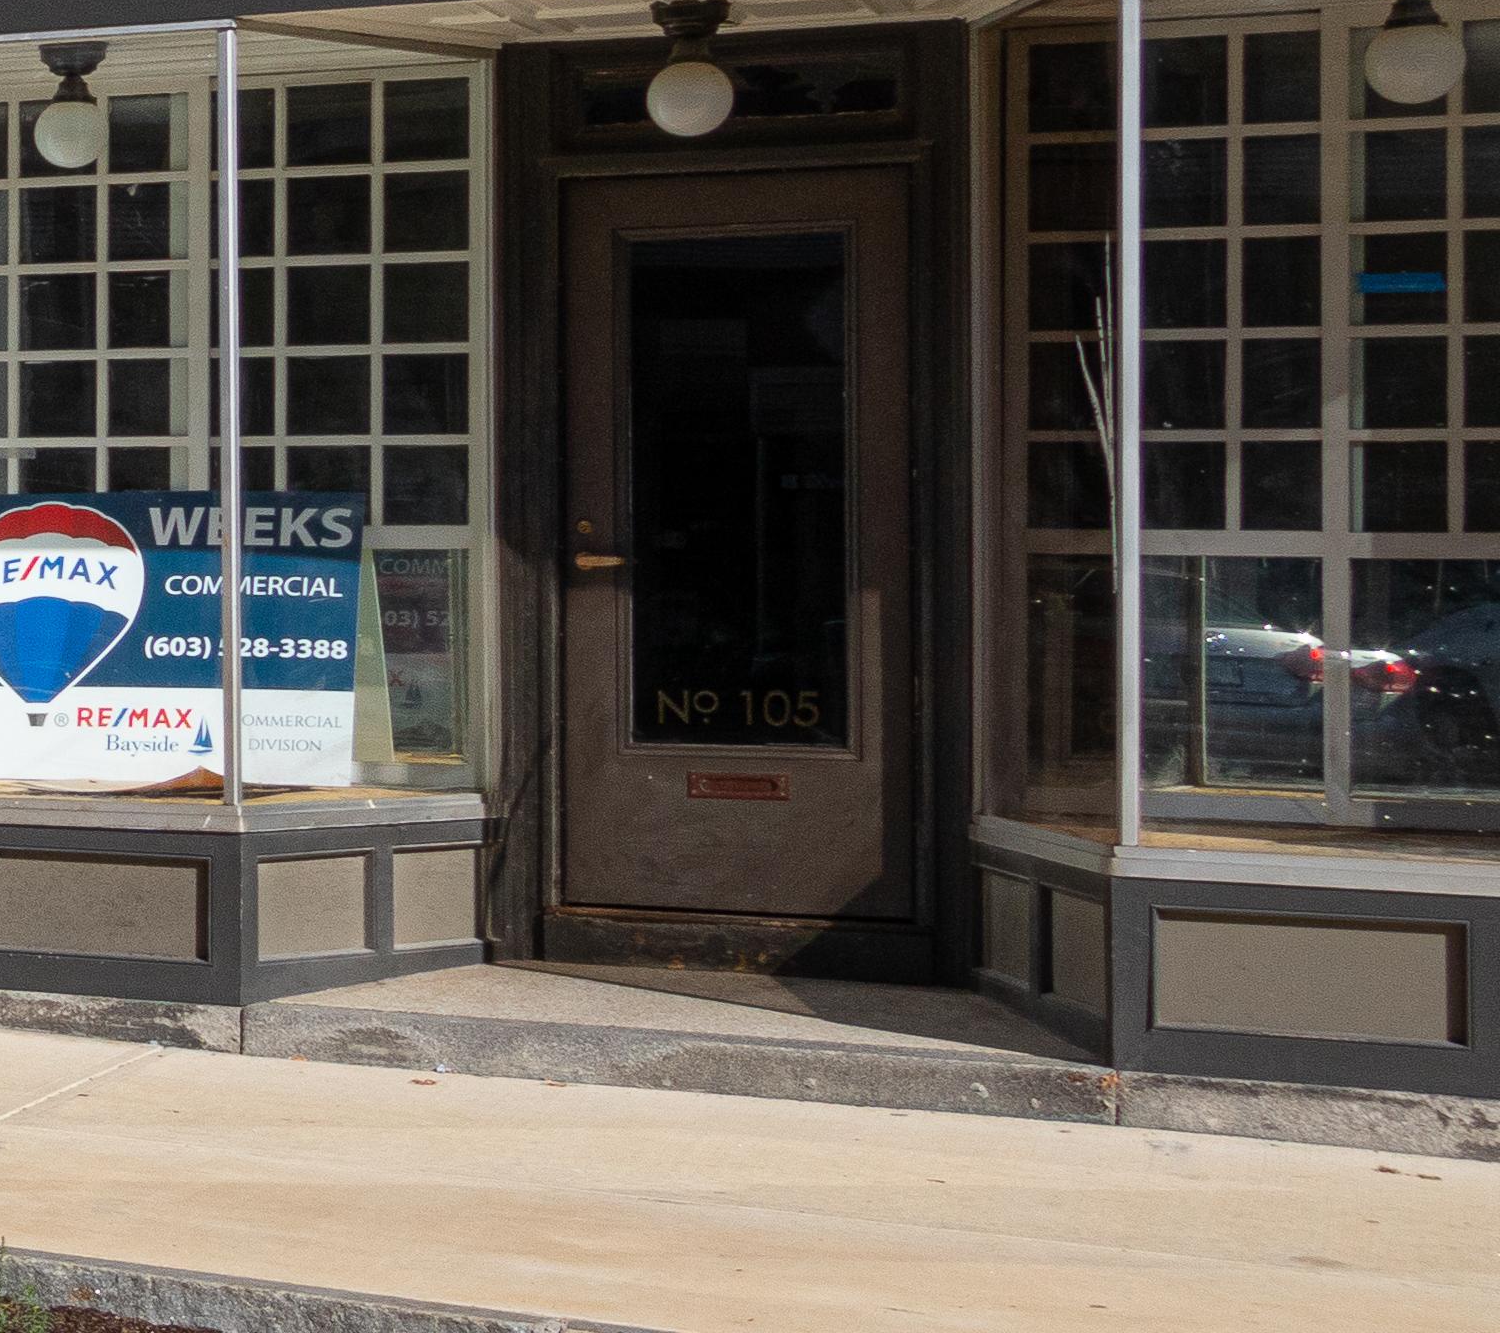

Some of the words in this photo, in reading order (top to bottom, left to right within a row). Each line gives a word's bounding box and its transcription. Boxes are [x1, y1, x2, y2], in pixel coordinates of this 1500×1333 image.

[144, 635, 211, 659] (603)
[218, 636, 348, 660] 28-3388
[76, 707, 194, 729] RE/MAX
[739, 689, 820, 727] 105
[241, 714, 343, 729] OMMERCIAL
[105, 734, 180, 757] Bayside
[248, 737, 323, 752] DIVISION
